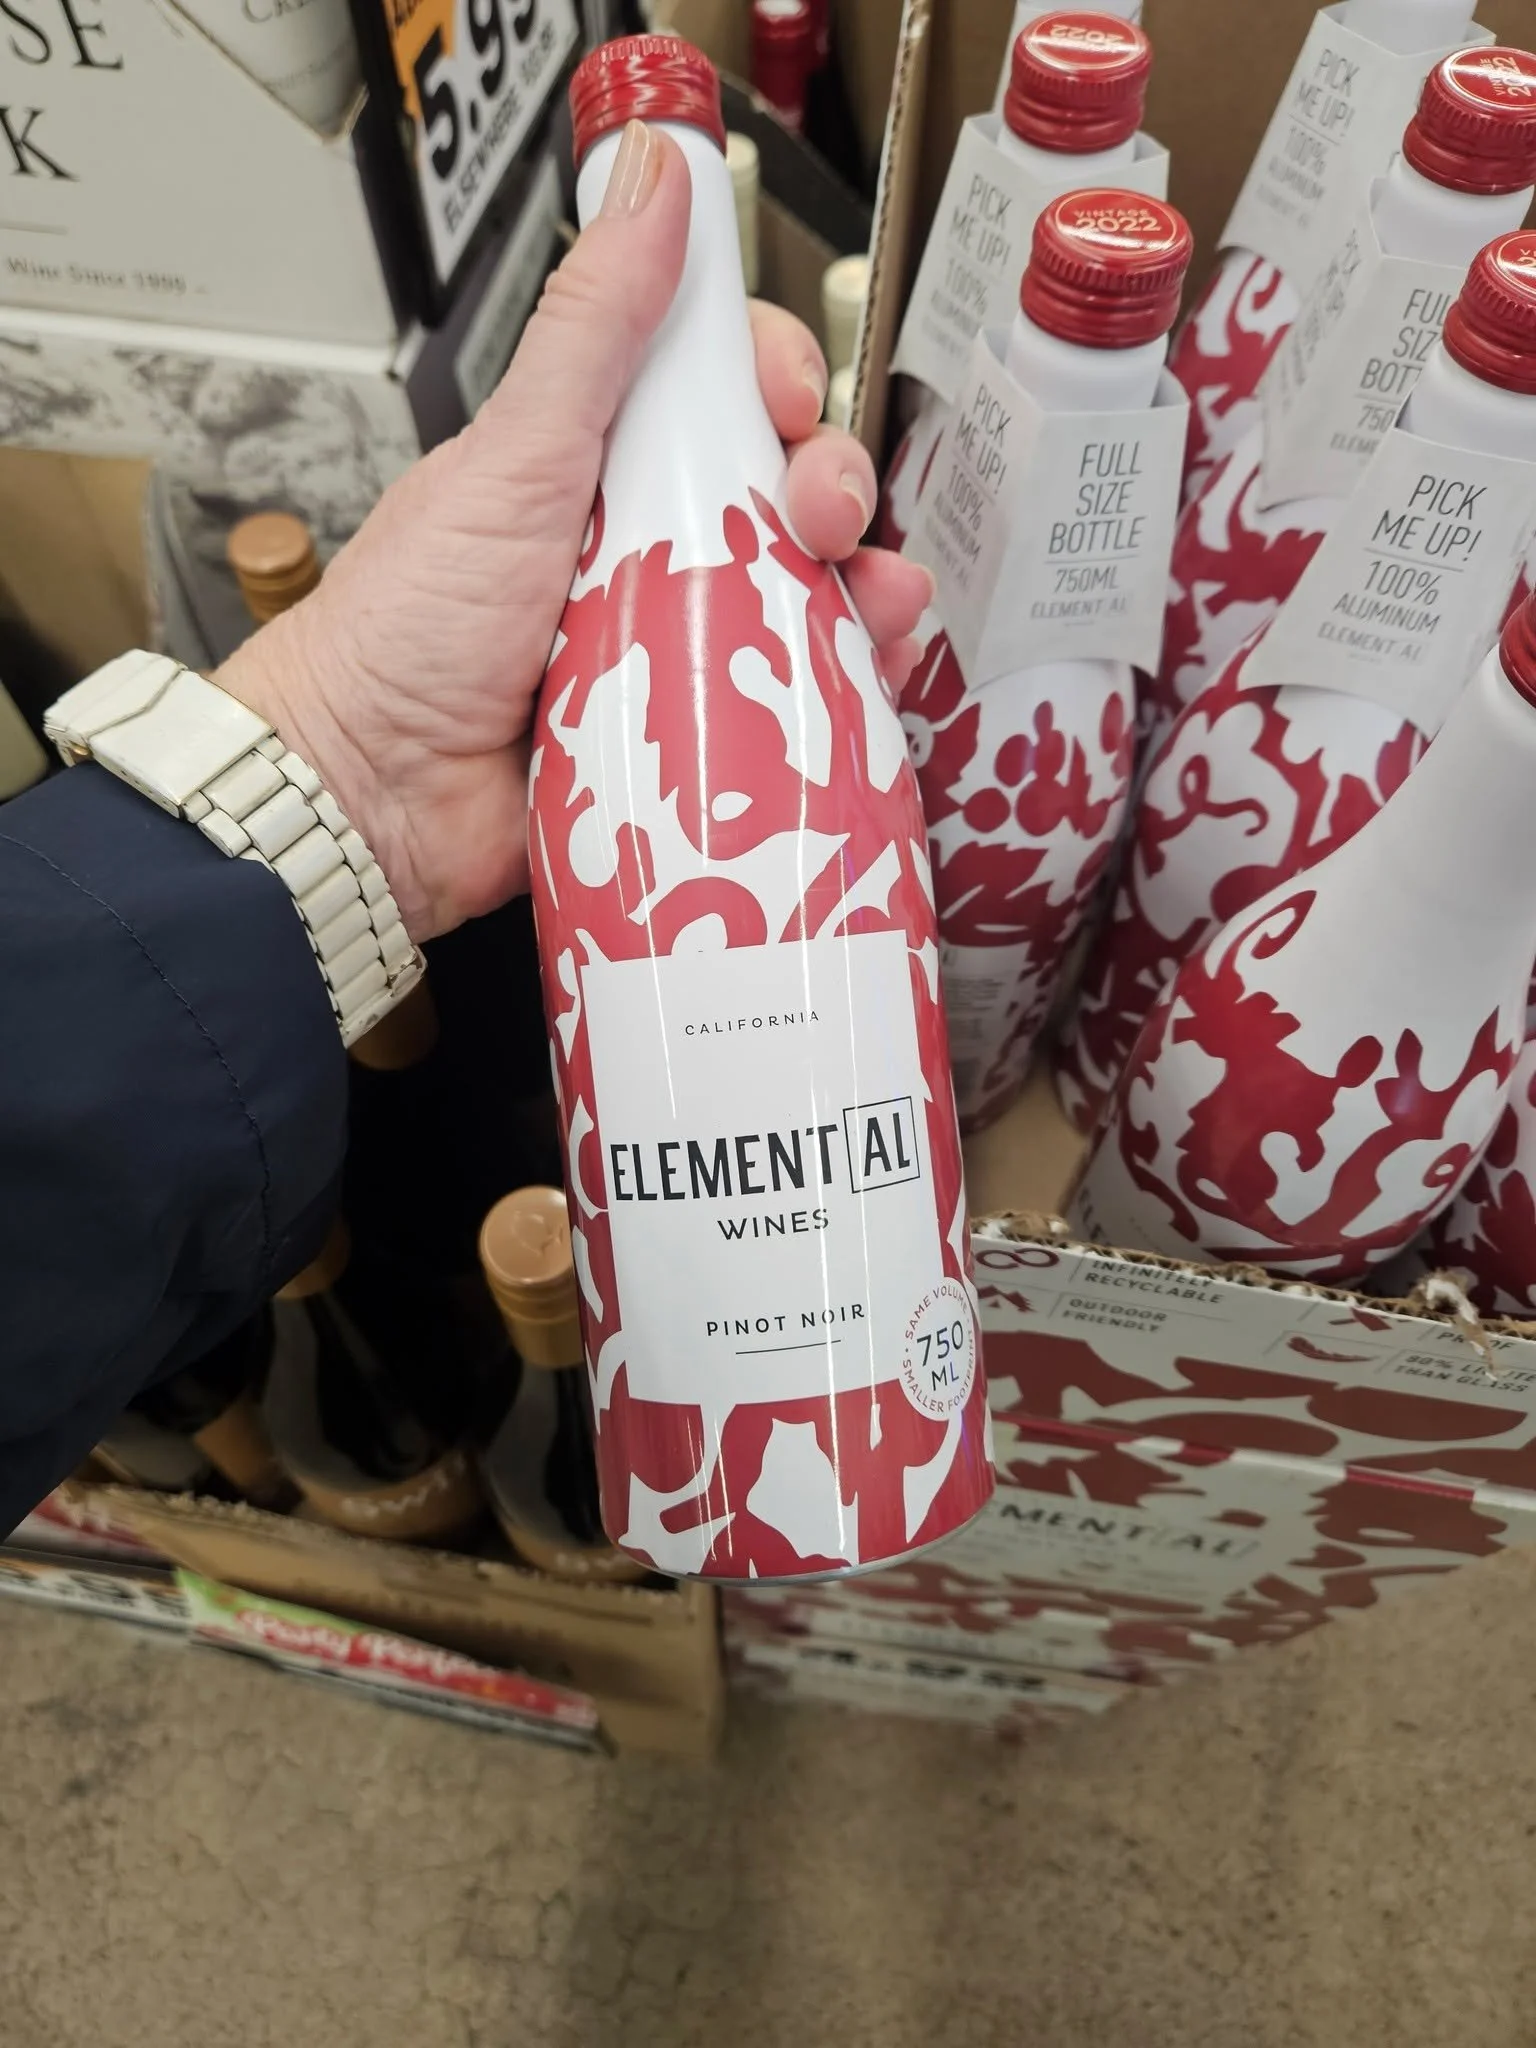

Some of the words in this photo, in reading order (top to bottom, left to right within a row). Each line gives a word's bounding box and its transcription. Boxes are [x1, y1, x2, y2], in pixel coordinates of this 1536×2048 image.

[413, 0, 537, 181] 5.9
[1313, 48, 1361, 97] PICK
[968, 173, 1012, 230] PICK
[1075, 216, 1162, 233] 2022
[977, 229, 1011, 266] UP!
[1403, 288, 1451, 325] FUL
[1392, 326, 1438, 362] SIZ
[973, 382, 1012, 448] PICK
[1357, 404, 1396, 433] 750
[976, 440, 1008, 495] UP!
[1078, 441, 1143, 478] FULL
[1075, 480, 1135, 517] SIZE
[1407, 474, 1488, 520] PICK
[1048, 516, 1147, 554] BOTTLE
[1371, 509, 1425, 550] ME
[1424, 521, 1482, 562] UP!
[1054, 565, 1120, 593] 750ML
[1364, 560, 1442, 606] 100%
[1332, 592, 1441, 635] ALUMINUM
[684, 1010, 820, 1036] CALIFORNIA
[717, 1208, 830, 1241] WINES
[1085, 1272, 1225, 1304] RECYCLABLE
[1091, 1259, 1213, 1288] INFINITELY
[706, 1315, 786, 1336] PINOT
[801, 1303, 865, 1328] NOIR
[904, 1295, 932, 1341] SAME
[1062, 1309, 1160, 1333] FRIENDLY
[1069, 1297, 1168, 1322] OUTDOOR
[916, 1320, 964, 1367] 750
[1437, 1331, 1515, 1350] PRF
[902, 1358, 944, 1413] SMALLER
[931, 1361, 960, 1391] ML
[1394, 1365, 1452, 1380] THAN
